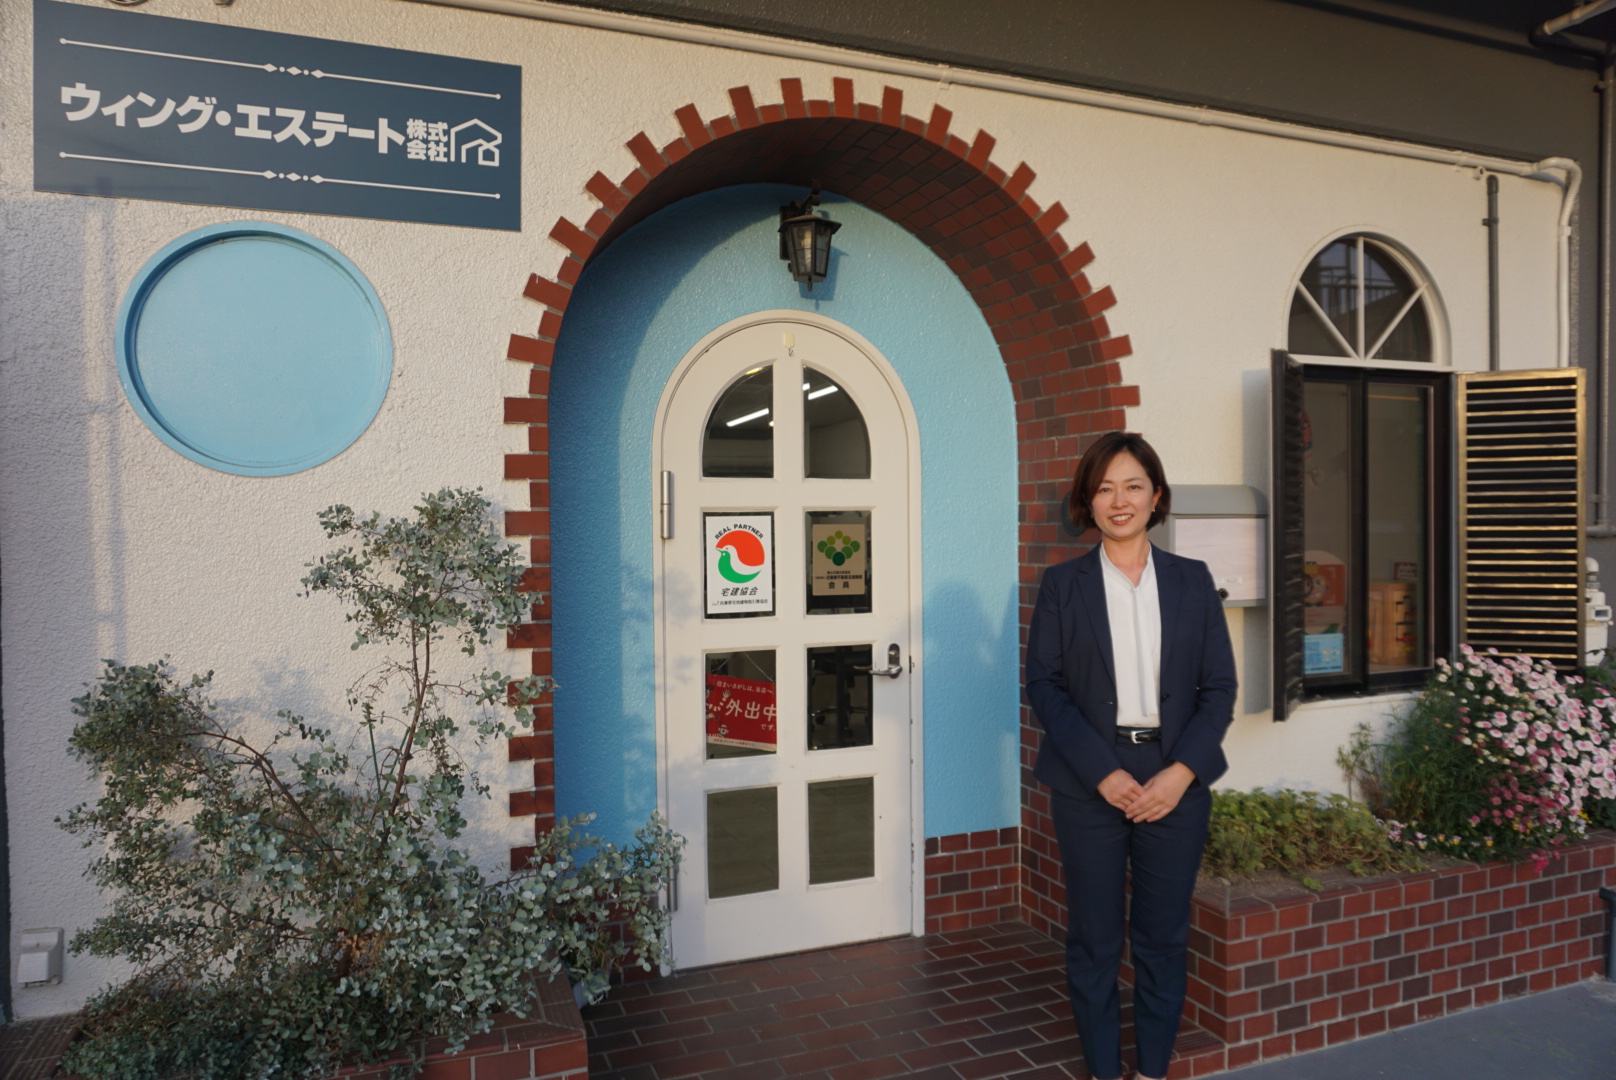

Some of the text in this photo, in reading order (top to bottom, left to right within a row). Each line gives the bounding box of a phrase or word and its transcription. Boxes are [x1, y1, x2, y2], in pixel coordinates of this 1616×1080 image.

[714, 523, 764, 540] REAL PARTNER
[721, 586, 758, 597] 宅建協会
[725, 698, 777, 722] 外出中
